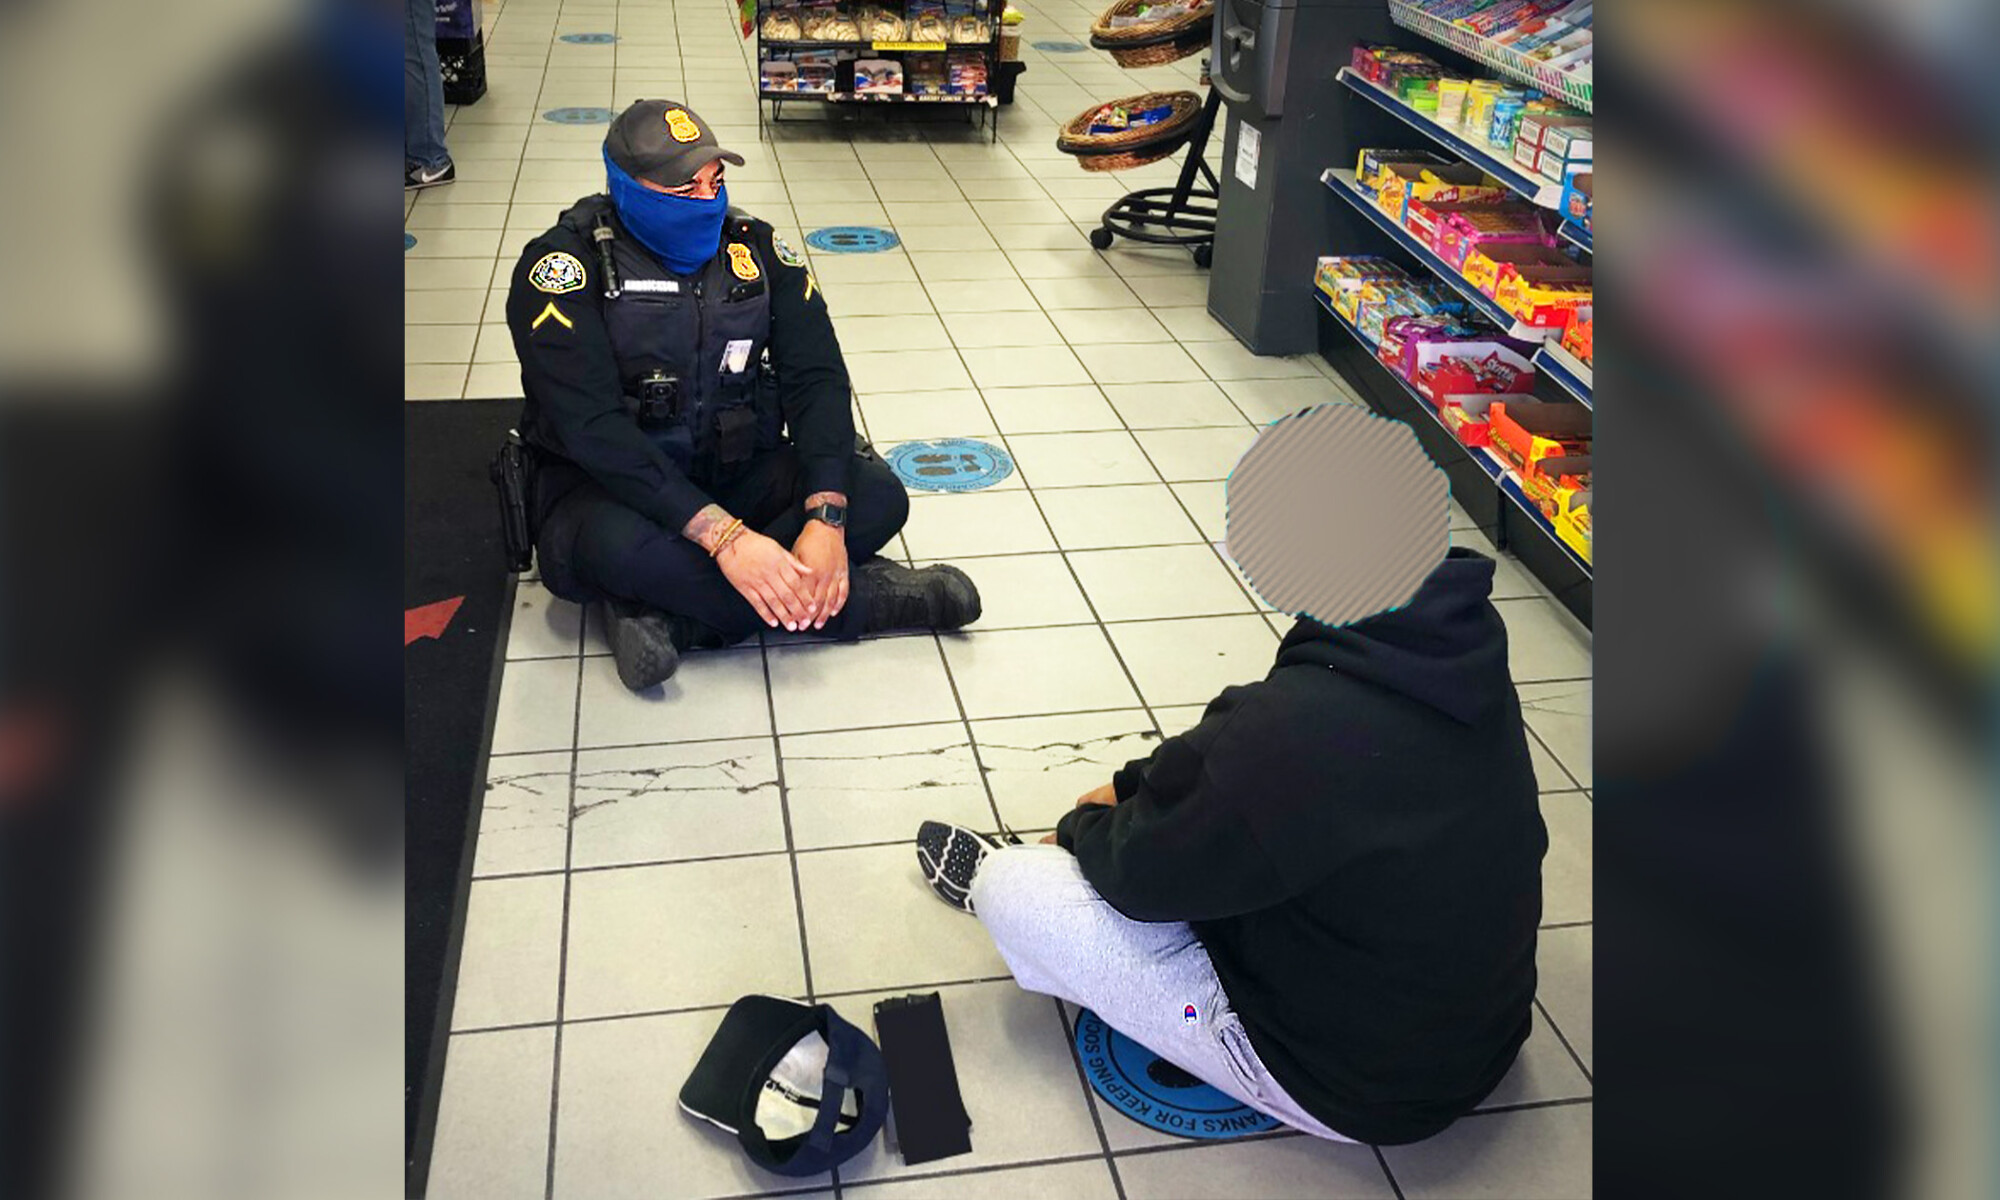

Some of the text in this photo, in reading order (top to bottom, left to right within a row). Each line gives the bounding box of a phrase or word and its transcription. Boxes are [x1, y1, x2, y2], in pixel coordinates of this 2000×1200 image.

[1083, 1018, 1268, 1133] HANKS FOR KEEPING SOCI
